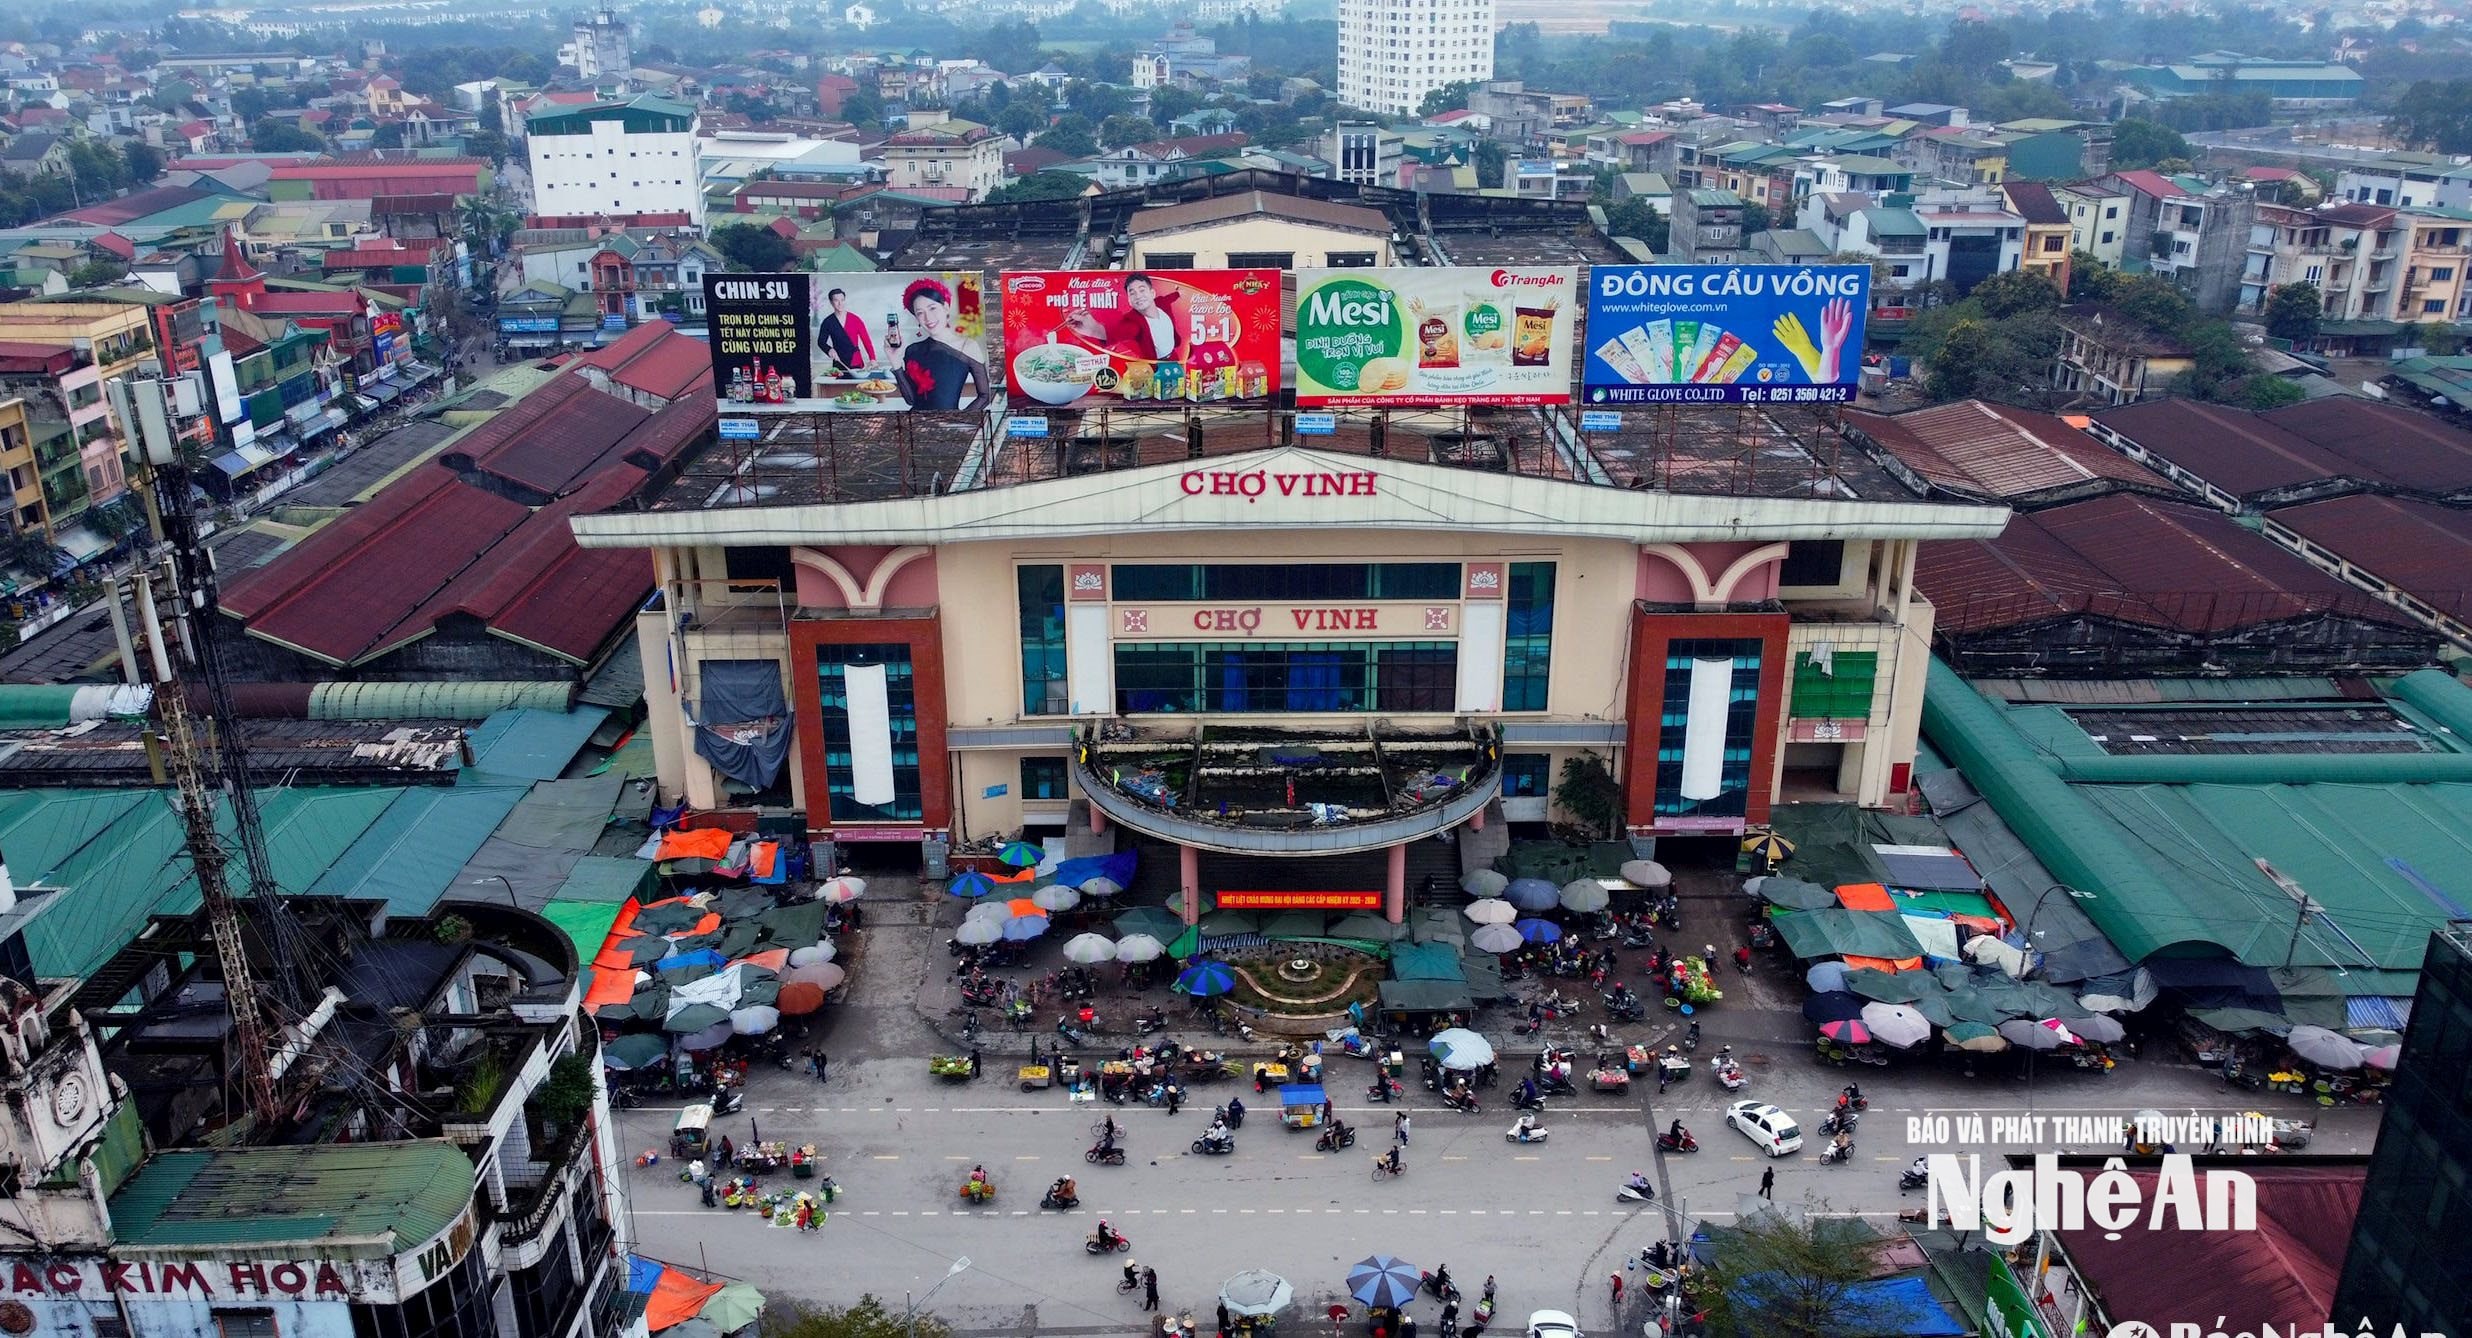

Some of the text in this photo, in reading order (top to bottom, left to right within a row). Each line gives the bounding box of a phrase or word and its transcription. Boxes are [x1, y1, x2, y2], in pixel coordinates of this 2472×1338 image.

[1068, 277, 1089, 289] Khai
[1601, 267, 1860, 296] ĐÔNG CẦU VỒNG
[715, 281, 790, 299] CHIN-SU
[1046, 288, 1119, 310] PHỞ ĐỆ NHẤT
[1309, 289, 1394, 326] Mesi
[1602, 301, 1728, 314] www.whiteglove.com.vn
[718, 312, 794, 327] TRỌN BỘ CHIN-SU
[720, 325, 734, 337] TẾT
[736, 327, 751, 338] NÀY
[782, 328, 796, 338] VUI
[1191, 314, 1230, 345] 5+1
[752, 339, 773, 353] VÀO
[775, 338, 796, 353] BẾP
[1306, 336, 1330, 349] DINH
[1328, 396, 1341, 404] SẢN
[1376, 395, 1394, 404] CÔNG
[1511, 394, 1524, 404] VIỆT
[1609, 387, 1725, 402] WHITE GLOVE CO.,LTD
[1740, 387, 1847, 401] Tel: 0251 3560 421-2
[1180, 469, 1378, 504] CHỢ VINH
[1193, 607, 1378, 636] CHỢ VINH
[0, 1261, 350, 1297] ẠC KIM HOA
